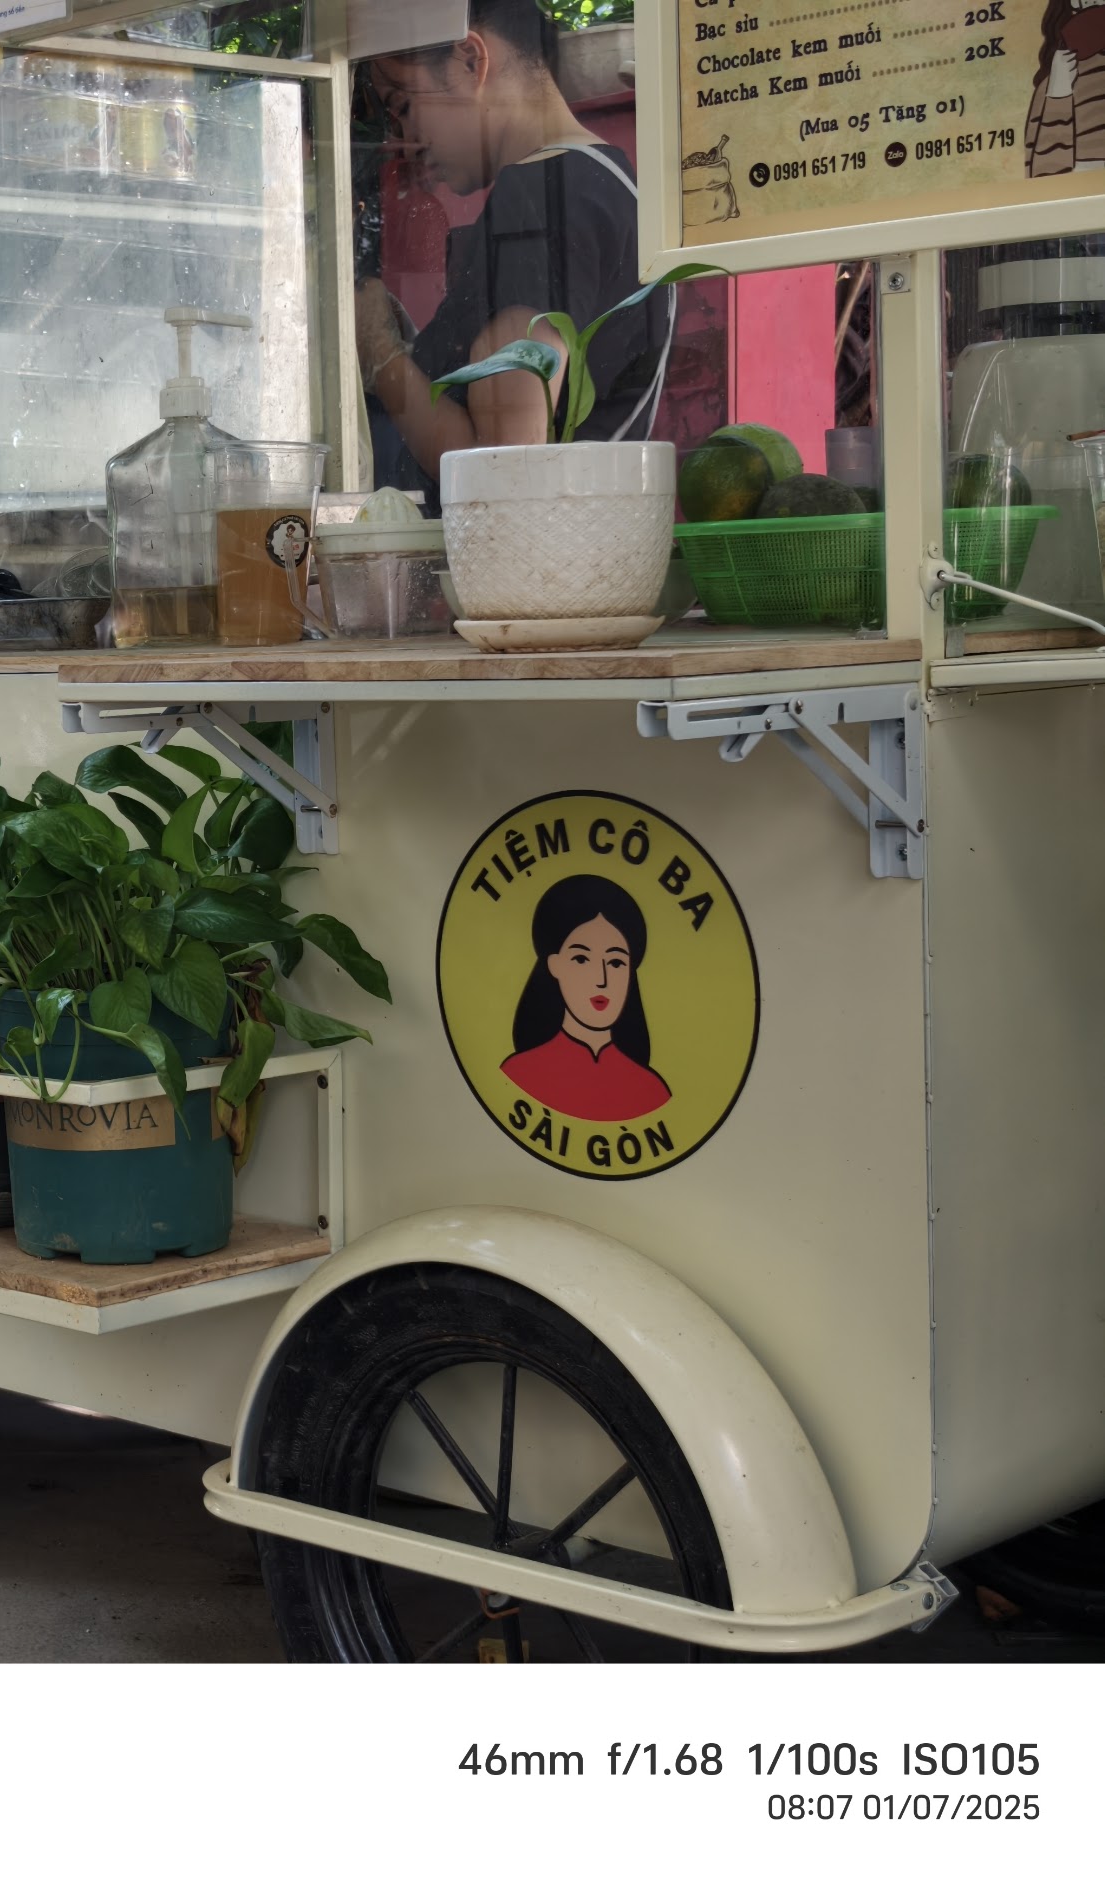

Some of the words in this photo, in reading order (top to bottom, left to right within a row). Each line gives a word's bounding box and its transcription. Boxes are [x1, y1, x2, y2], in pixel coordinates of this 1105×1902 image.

[695, 23, 725, 42] Bạc
[736, 14, 759, 33] sỉu
[697, 47, 781, 75] Chocolate
[791, 38, 828, 58] kem
[838, 22, 882, 49] muối
[965, 1, 1005, 26] 20K
[697, 83, 759, 107] Matcha
[769, 76, 808, 95] Kem
[818, 60, 861, 86] muối
[965, 37, 1005, 62] 20K
[799, 117, 839, 142] (Mua
[848, 112, 870, 132] 05
[879, 103, 927, 123] Tặng
[936, 95, 965, 117] 01)
[774, 160, 806, 181] 0981
[811, 155, 836, 176] 651
[841, 151, 866, 171] 719
[915, 138, 951, 160] 0981
[956, 133, 982, 155] 651
[988, 128, 1015, 150] 719
[471, 818, 570, 902] TIỆM
[588, 818, 651, 865] CÔ
[658, 855, 714, 932] BA
[11, 1100, 158, 1133] MONROVIA
[508, 1098, 570, 1157] SÀI
[586, 1120, 675, 1167] GÒN
